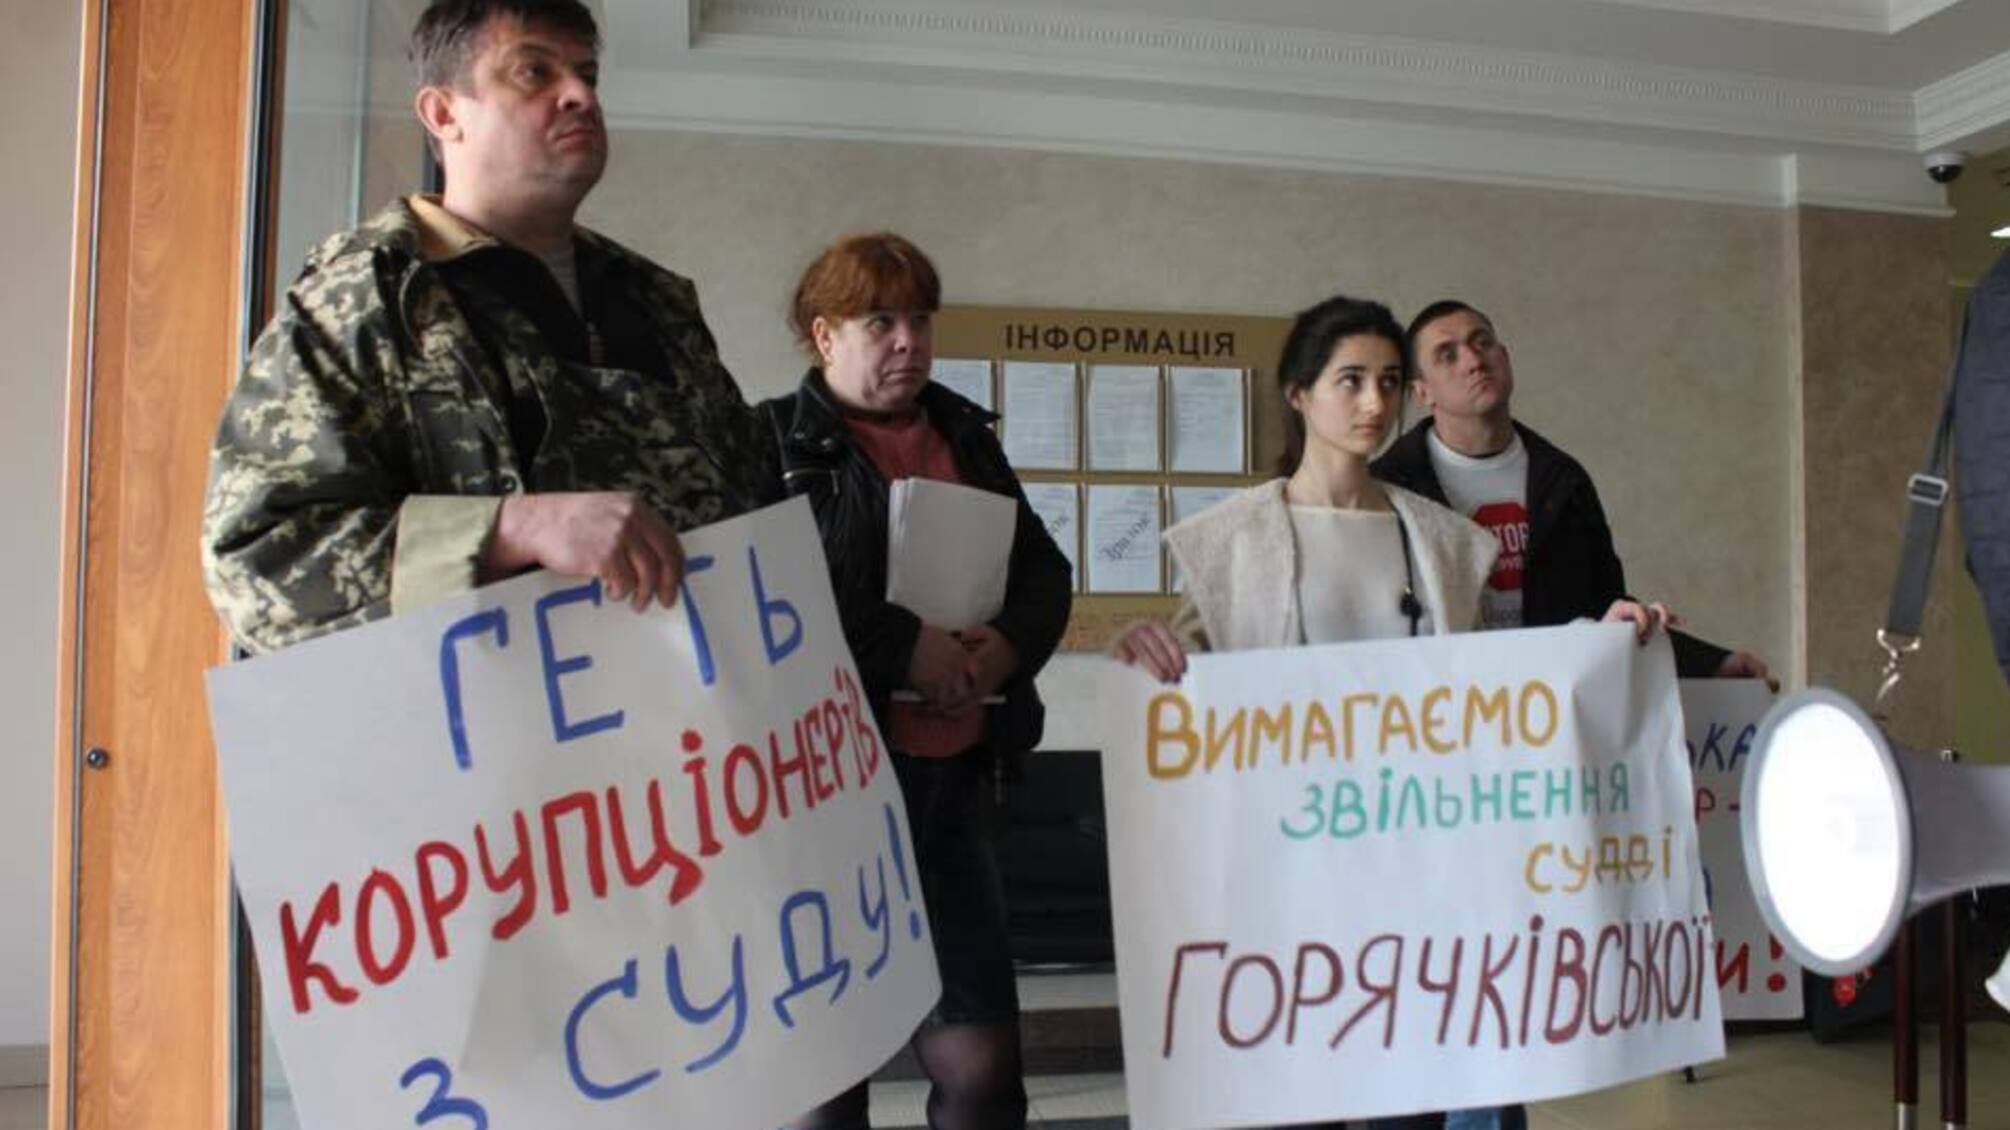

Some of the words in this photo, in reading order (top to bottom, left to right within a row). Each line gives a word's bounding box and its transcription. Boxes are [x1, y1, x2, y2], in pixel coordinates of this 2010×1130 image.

[1004, 324, 1236, 360] ІНФОРМАЦІЯ
[440, 545, 803, 770] ГЕТЬ
[279, 664, 878, 1014] КОРУПЦІОНЕРІВ
[564, 804, 922, 1100] СУДУ!
[1163, 914, 1710, 1058] ГОРЯЧКІВСЬКОЇ
